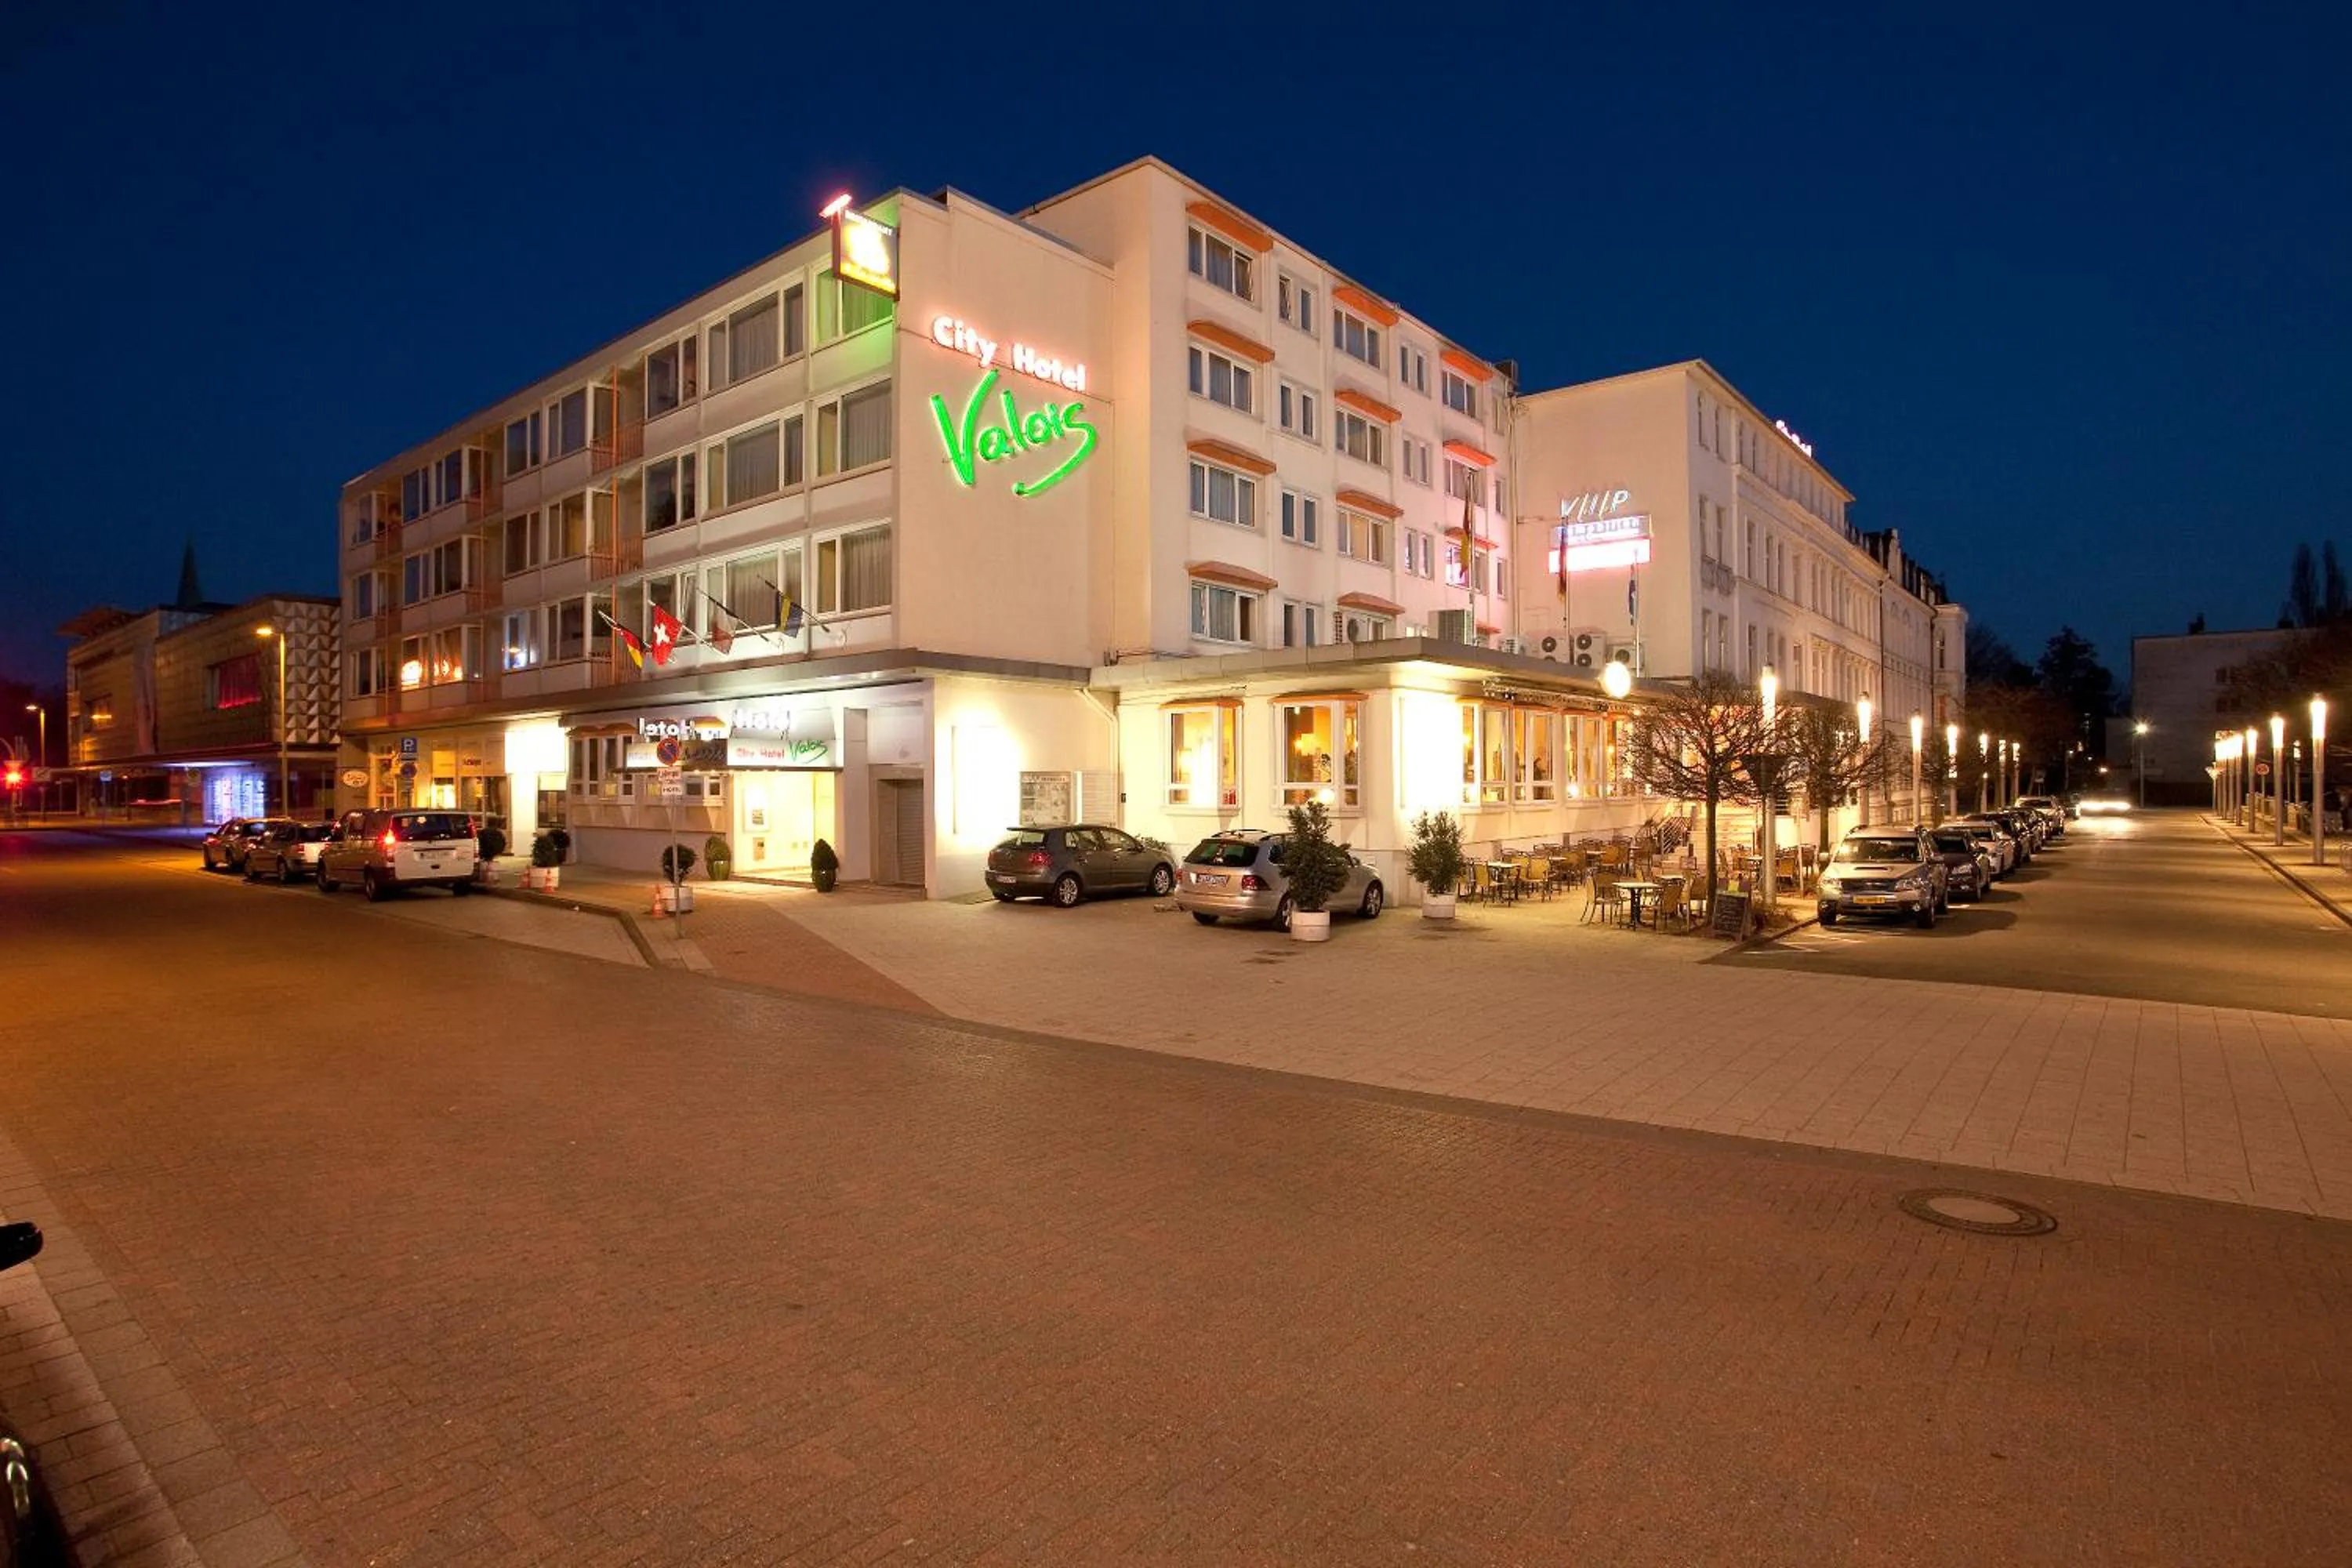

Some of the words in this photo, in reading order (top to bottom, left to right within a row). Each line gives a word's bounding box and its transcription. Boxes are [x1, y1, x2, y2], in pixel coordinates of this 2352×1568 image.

[933, 316, 996, 366] City
[1012, 343, 1087, 391] Hotel
[930, 368, 1097, 496] Valois
[403, 739, 415, 751] P
